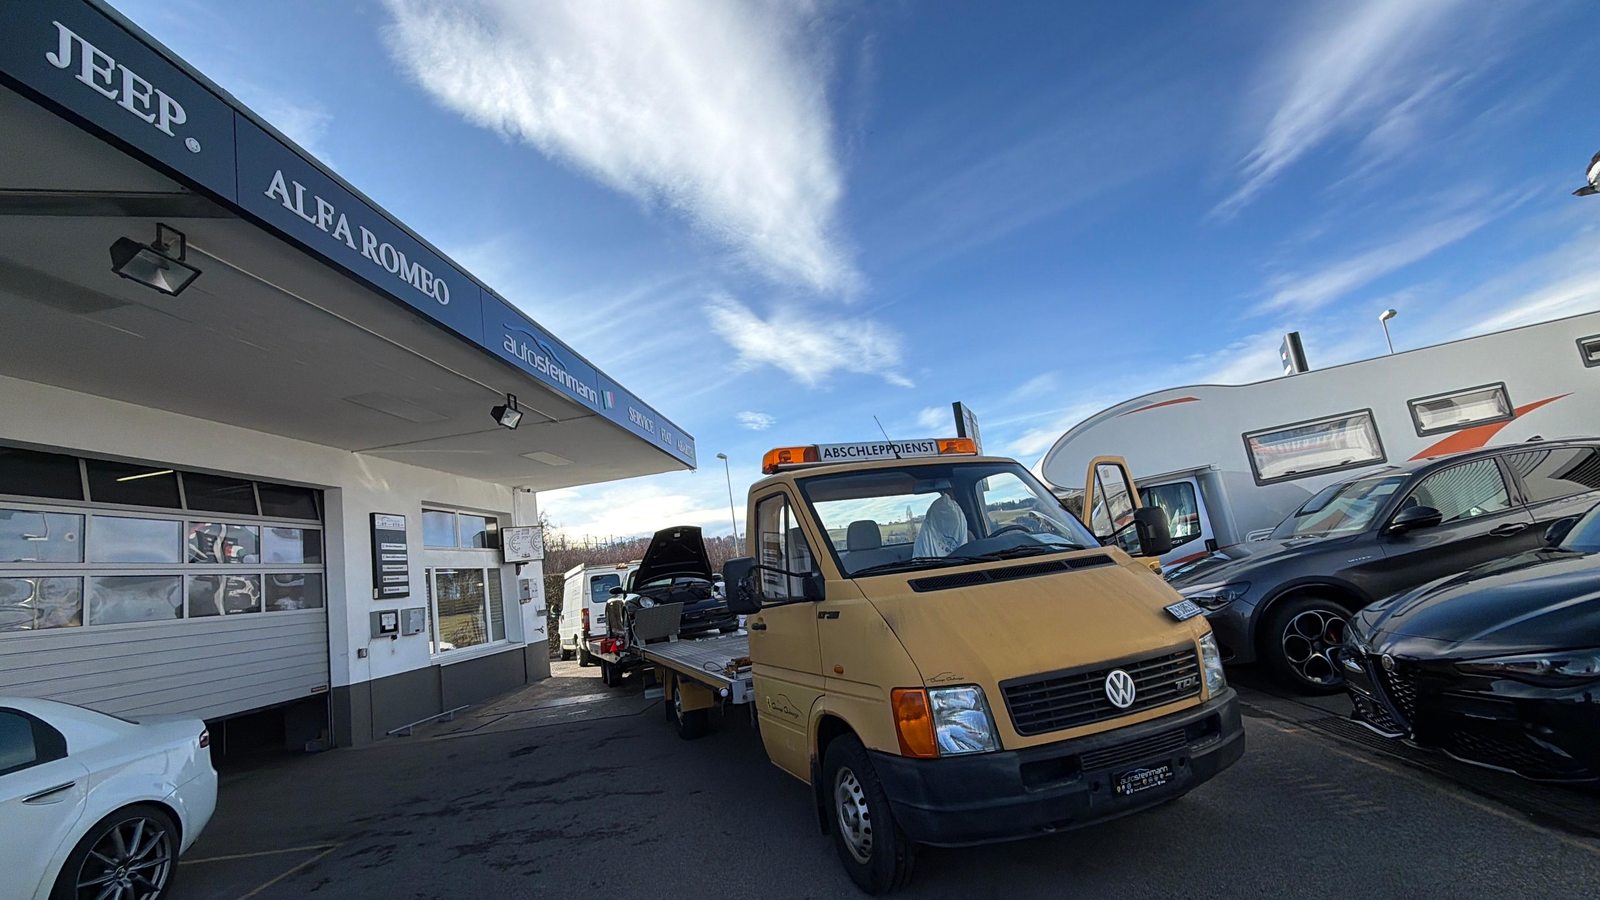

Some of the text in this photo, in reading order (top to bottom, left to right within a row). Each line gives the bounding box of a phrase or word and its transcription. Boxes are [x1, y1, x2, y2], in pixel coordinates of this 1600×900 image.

[45, 20, 187, 137] JEEP
[264, 169, 450, 306] ALFA ROMEO
[503, 333, 598, 405] autosteinmann
[628, 406, 655, 434] SERVICE
[823, 442, 934, 459] ABSCHLEPPDIENST
